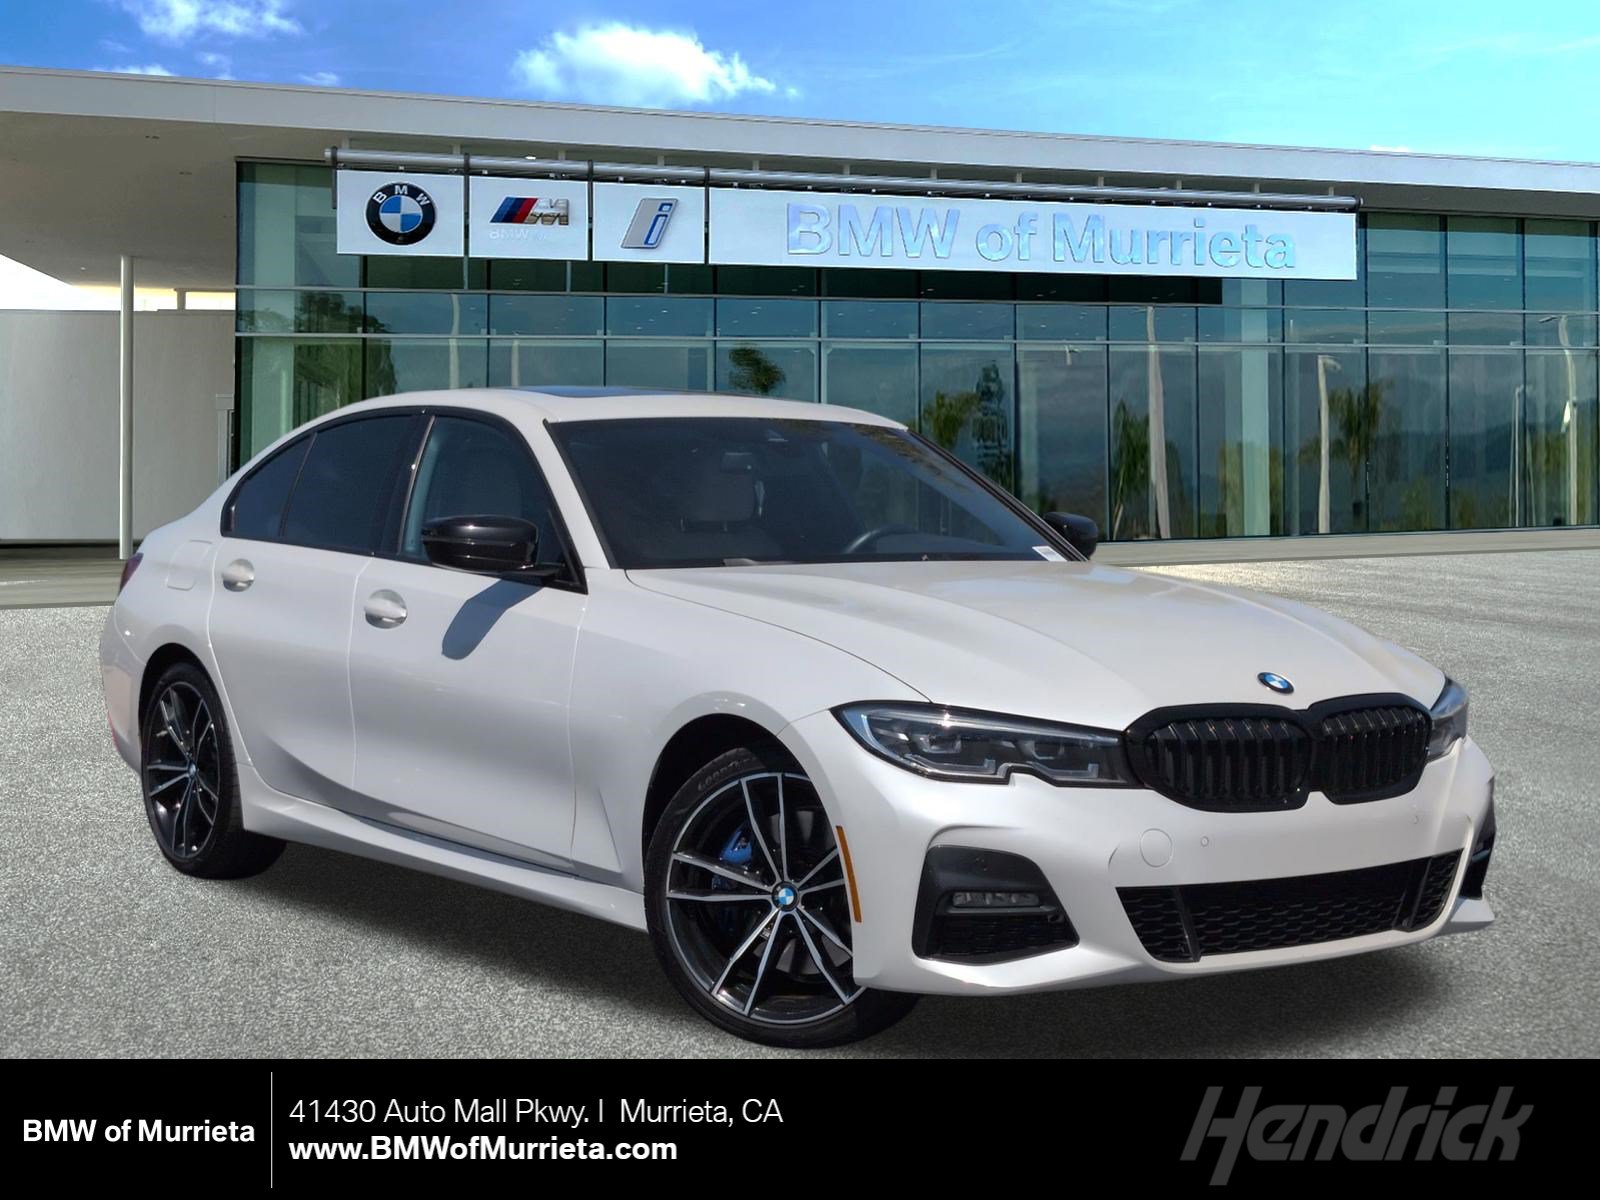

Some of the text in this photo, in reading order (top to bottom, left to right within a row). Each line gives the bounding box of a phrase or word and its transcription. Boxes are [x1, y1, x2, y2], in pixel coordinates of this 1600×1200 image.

[372, 183, 432, 207] BMW
[786, 202, 1296, 269] BMW of Murrieta
